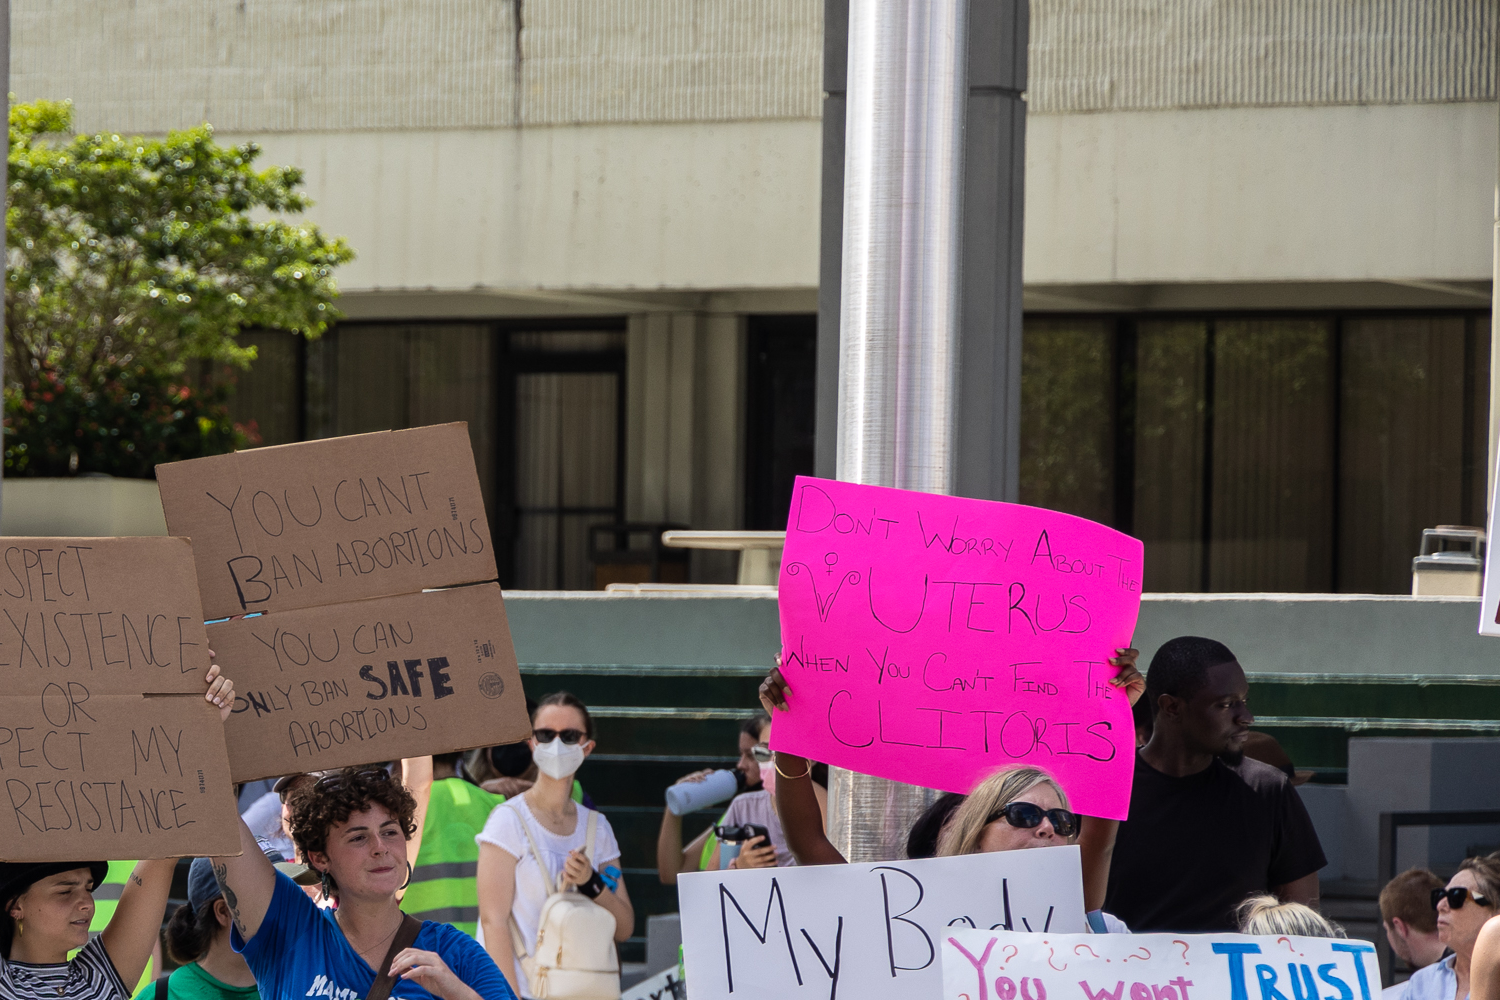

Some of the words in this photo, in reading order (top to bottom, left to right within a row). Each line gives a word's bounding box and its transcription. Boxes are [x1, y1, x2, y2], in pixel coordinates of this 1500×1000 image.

[206, 484, 322, 553] YOU
[334, 471, 430, 522] CANT
[226, 549, 323, 611] BAN
[336, 518, 485, 578] ABORTIONS
[868, 566, 1092, 635] UTERUS
[251, 627, 340, 672] YOU
[352, 621, 414, 655] CAN
[41, 681, 98, 728] OR
[231, 684, 293, 718] ONLY
[301, 678, 349, 707] BAN
[358, 656, 455, 700] SAFE
[132, 725, 184, 777] MY
[288, 705, 428, 757] ABORTIONS
[828, 689, 1116, 762] CLITORIS
[5, 778, 197, 836] RESISTANCE
